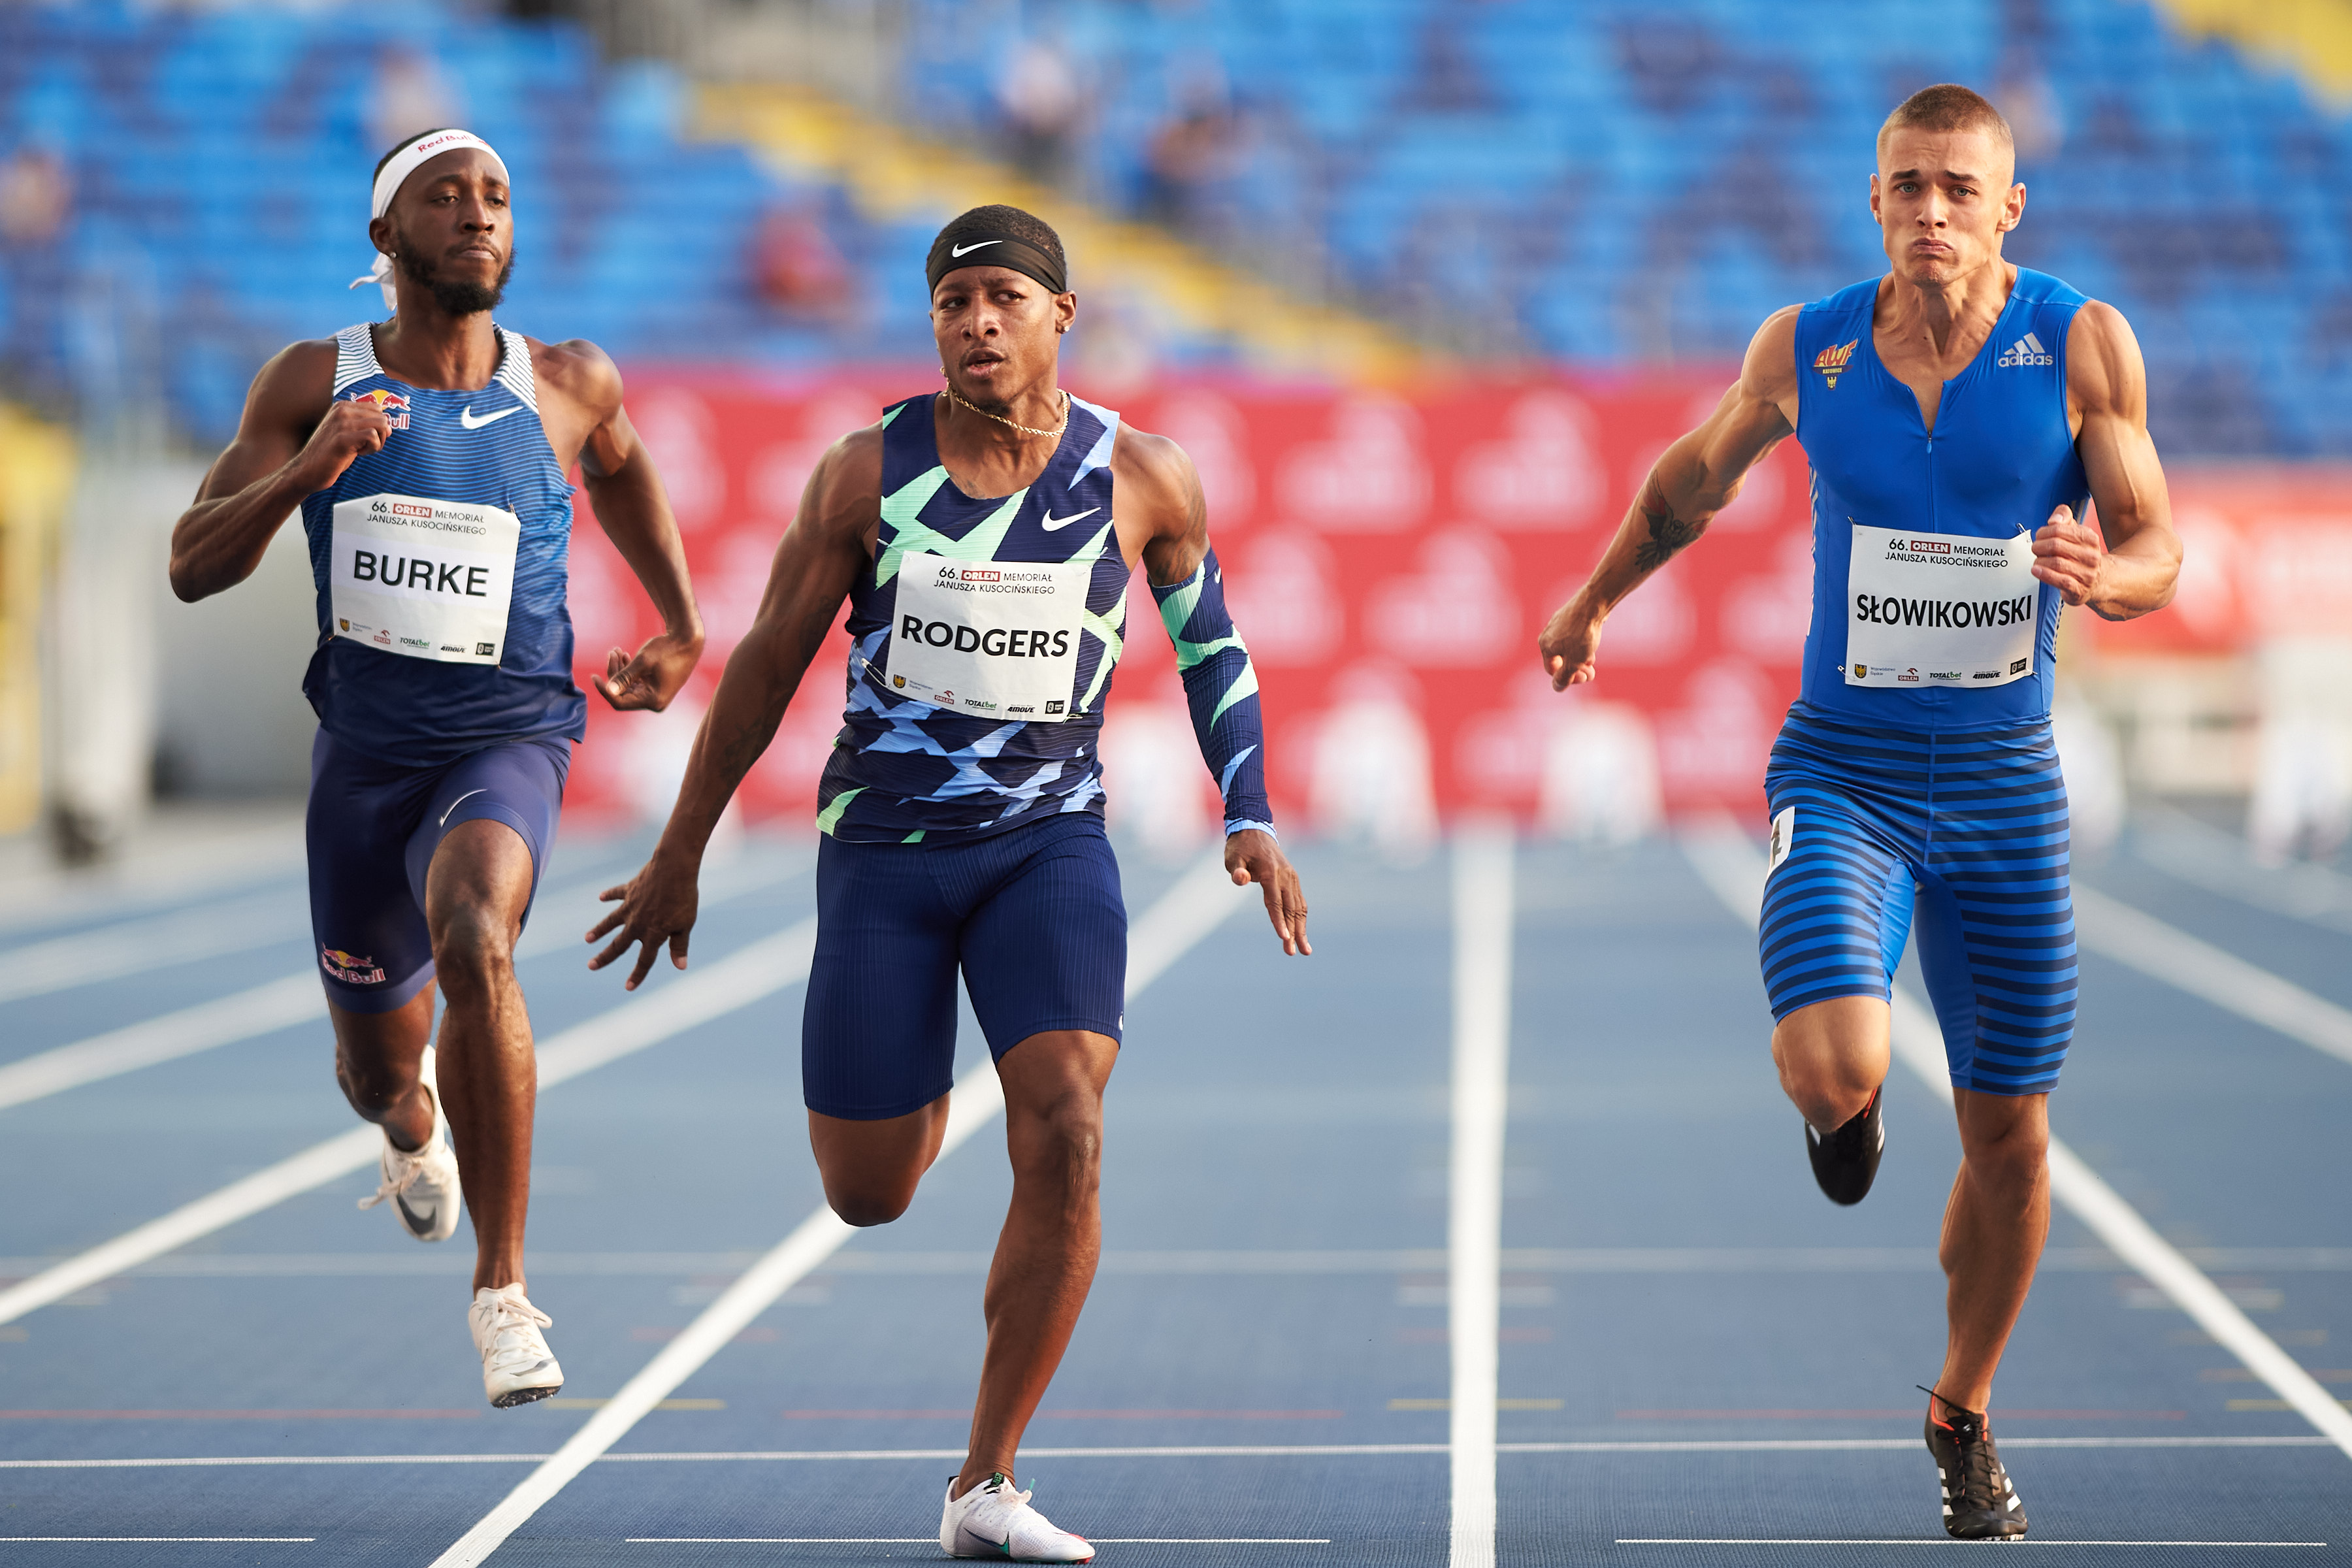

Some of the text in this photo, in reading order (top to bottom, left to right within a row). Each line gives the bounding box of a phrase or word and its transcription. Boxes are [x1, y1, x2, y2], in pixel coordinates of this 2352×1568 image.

[418, 137, 444, 153] Red
[1814, 338, 1858, 367] AWF
[1998, 353, 2053, 367] adidas
[372, 501, 484, 523] 66. ORLEN MEMORIAŁ
[367, 514, 487, 535] JANUSZA KUSOCIŃSKIEGO
[1889, 538, 2005, 556] 66. ORLEN MEMORIAŁ
[1886, 552, 2008, 568] JANUSZA KUSOCIŃSKIEGO
[354, 549, 489, 597] BURKE
[939, 566, 1053, 581] 66. ORLEN MEMORIAŁ
[934, 580, 1055, 595] JANUSZA KUSOCIŃSKIEGO
[1857, 594, 2032, 629] SŁOWIKOWSKI
[400, 637, 431, 647] TOTALbet
[901, 614, 1070, 657] RODGERS
[935, 695, 954, 704] ORLEN
[964, 698, 997, 709] TOTALbet
[321, 953, 386, 984] Red Bull
